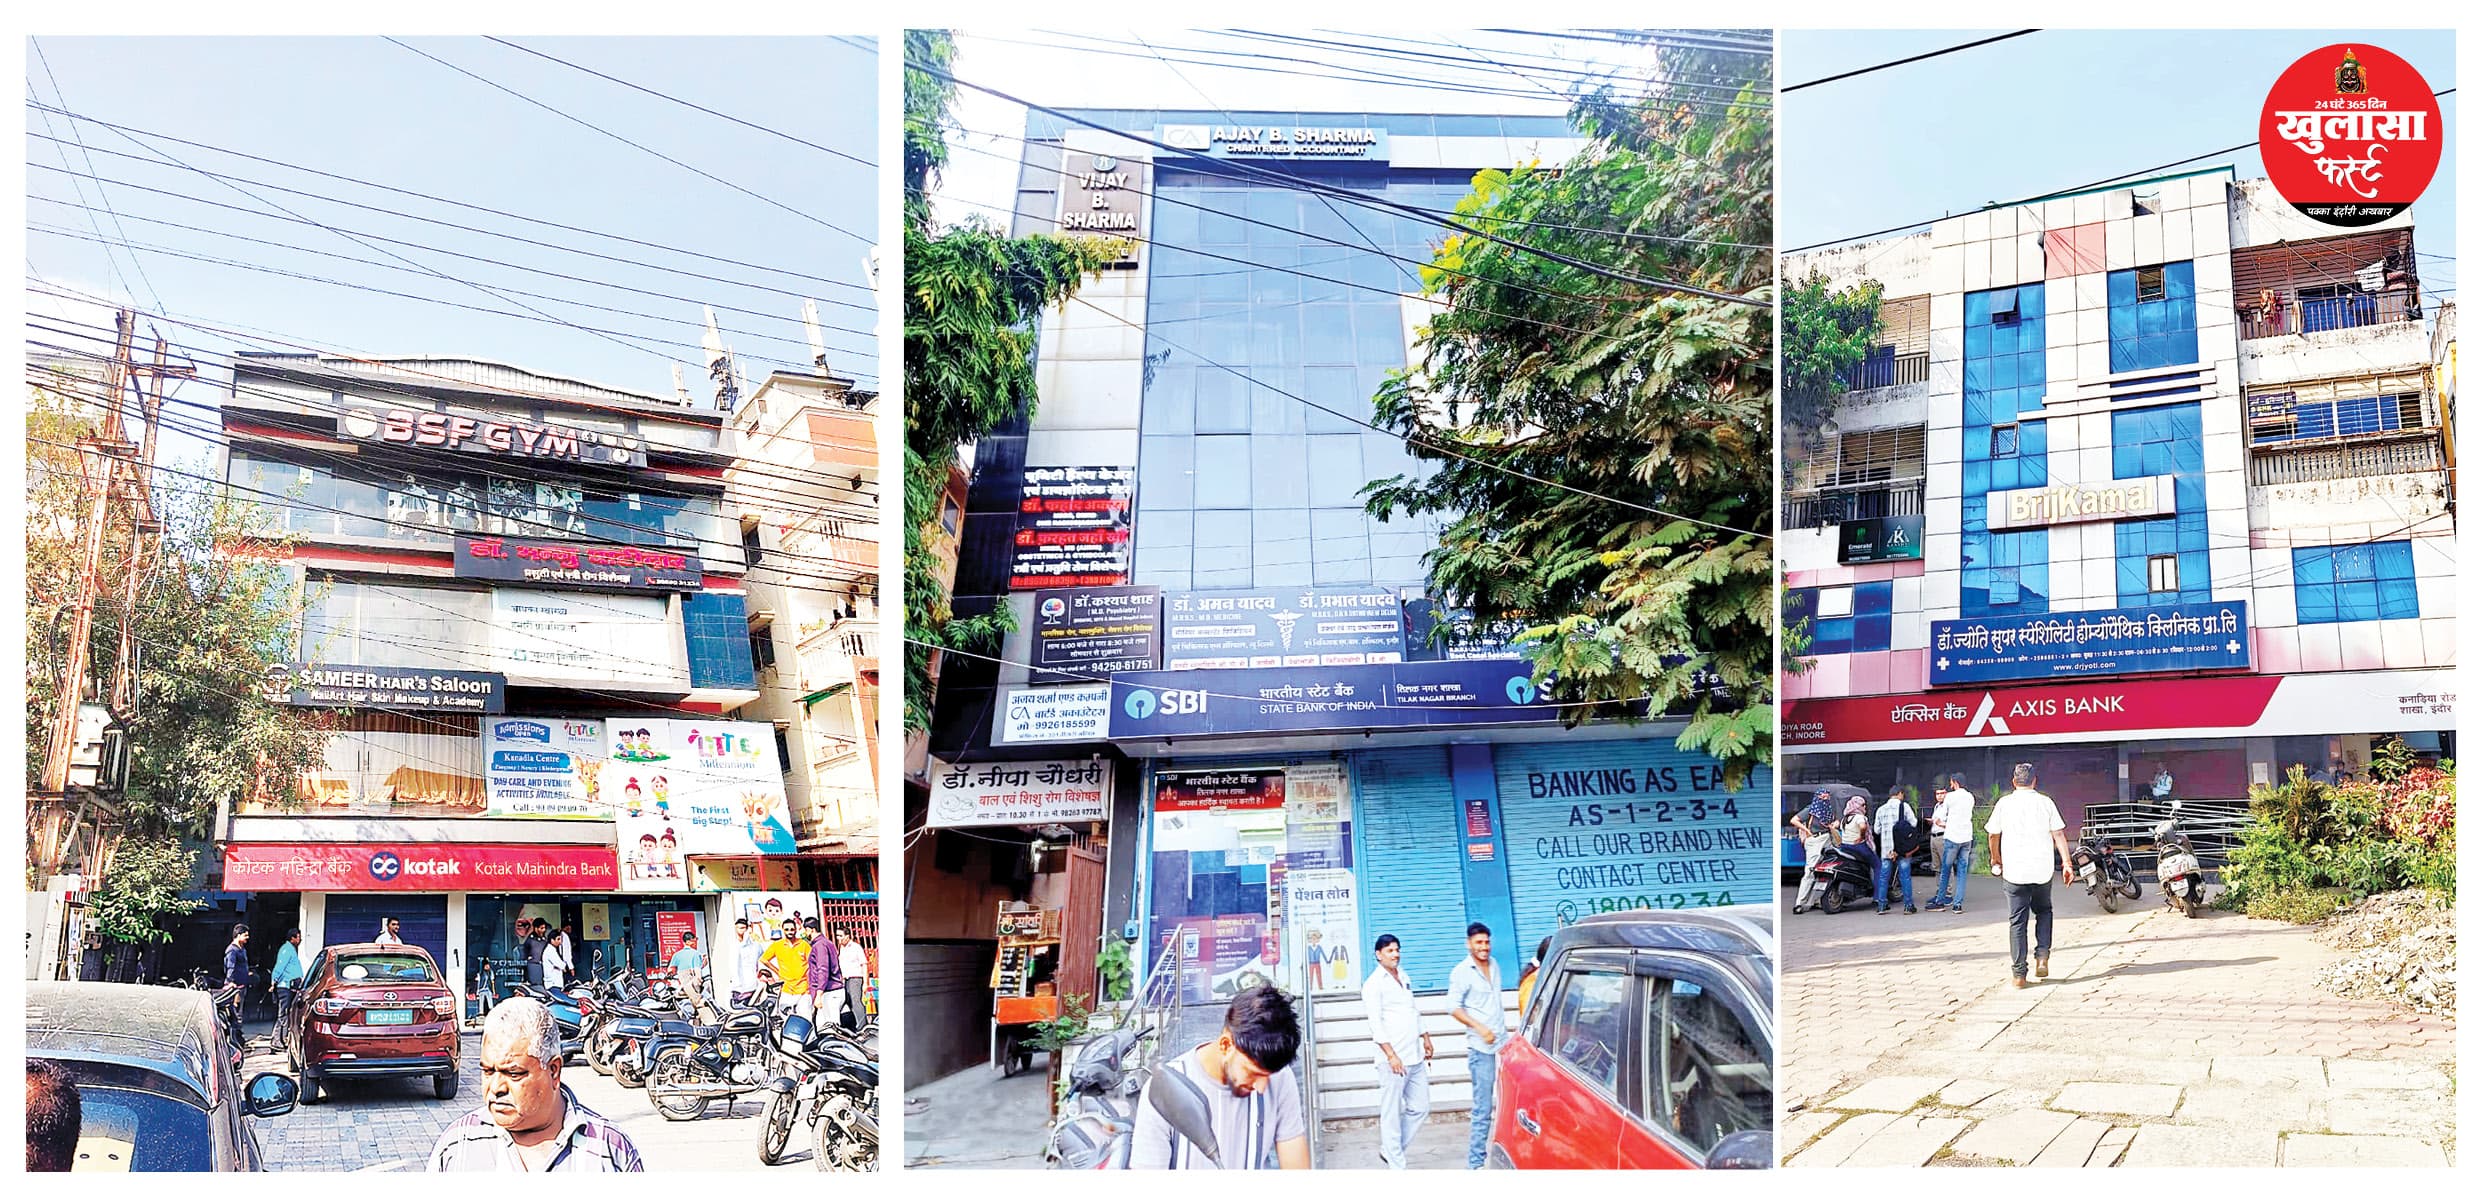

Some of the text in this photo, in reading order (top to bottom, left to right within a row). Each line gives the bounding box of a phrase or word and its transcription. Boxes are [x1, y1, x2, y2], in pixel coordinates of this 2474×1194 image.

[1213, 126, 1376, 145] AJAY B. SHARMA
[1225, 143, 1367, 156] CHARTERED ACCOUNTANT
[1077, 171, 1129, 188] VIJAY
[1092, 193, 1109, 209] B.
[1063, 211, 1136, 230] SHARMA
[382, 408, 581, 458] BSF GYM
[2010, 480, 2152, 524] BrijKamal
[468, 537, 509, 559] डॉ.
[1130, 594, 1154, 605] शाह
[1172, 594, 1275, 611] डॉ. अमन यादव
[1298, 591, 1396, 609] डॉ. प्रभात यादव
[1991, 628, 2016, 653] सुपर
[2076, 616, 2145, 644] होम्योपैथिक
[2147, 611, 2201, 638] क्लिनिक
[1091, 660, 1153, 672] 94250-61751
[2053, 662, 2116, 671] www.drjyoti.com
[299, 669, 377, 689] SAMEER
[430, 675, 491, 694] Saloon
[1396, 683, 1461, 694] तिलक नगर शाखा
[1012, 694, 1035, 705] अजय
[1036, 691, 1056, 704] शर्मा
[1259, 682, 1355, 699] भारतीय स्टेट बैंक
[1397, 695, 1418, 703] TILAK
[2440, 692, 2456, 702] रोड
[371, 692, 391, 703] Skin
[394, 693, 430, 706] Makeup
[432, 695, 440, 704] &
[442, 695, 485, 709] Academy
[1159, 688, 1207, 714] SBI
[1259, 701, 1376, 714] STATE BANK OF INDIA
[2009, 696, 2125, 717] AXIS BANK
[2430, 703, 2452, 714] इंदौर
[1891, 701, 1967, 724] ऐक्सिस बैंक
[500, 723, 546, 736] Admissions
[1035, 719, 1096, 730] 9926185599
[1795, 731, 1826, 739] INDORE
[535, 752, 560, 762] Centre
[508, 778, 525, 786] CARE
[1035, 762, 1103, 786] चौधरी
[1185, 774, 1257, 786] भारतीय स्टेट बैंक
[1527, 763, 1755, 799] BANKING AS EAY
[1002, 793, 1016, 806] एवं
[1019, 790, 1042, 807] शिशु
[1045, 790, 1062, 804] रोग
[1064, 788, 1101, 803] विशेषज्ञ
[690, 805, 729, 814] The First
[692, 817, 732, 827] Big Step!
[1536, 827, 1763, 859] CALL OUR BRAND NEW
[231, 855, 353, 876] कोटक महिन्द्रा बैंक
[404, 858, 460, 875] kotak
[475, 860, 612, 876] Kotak Mahindra Bank
[1557, 859, 1740, 890] CONTACT CENTER
[1295, 886, 1350, 901] पेंशन लोन
